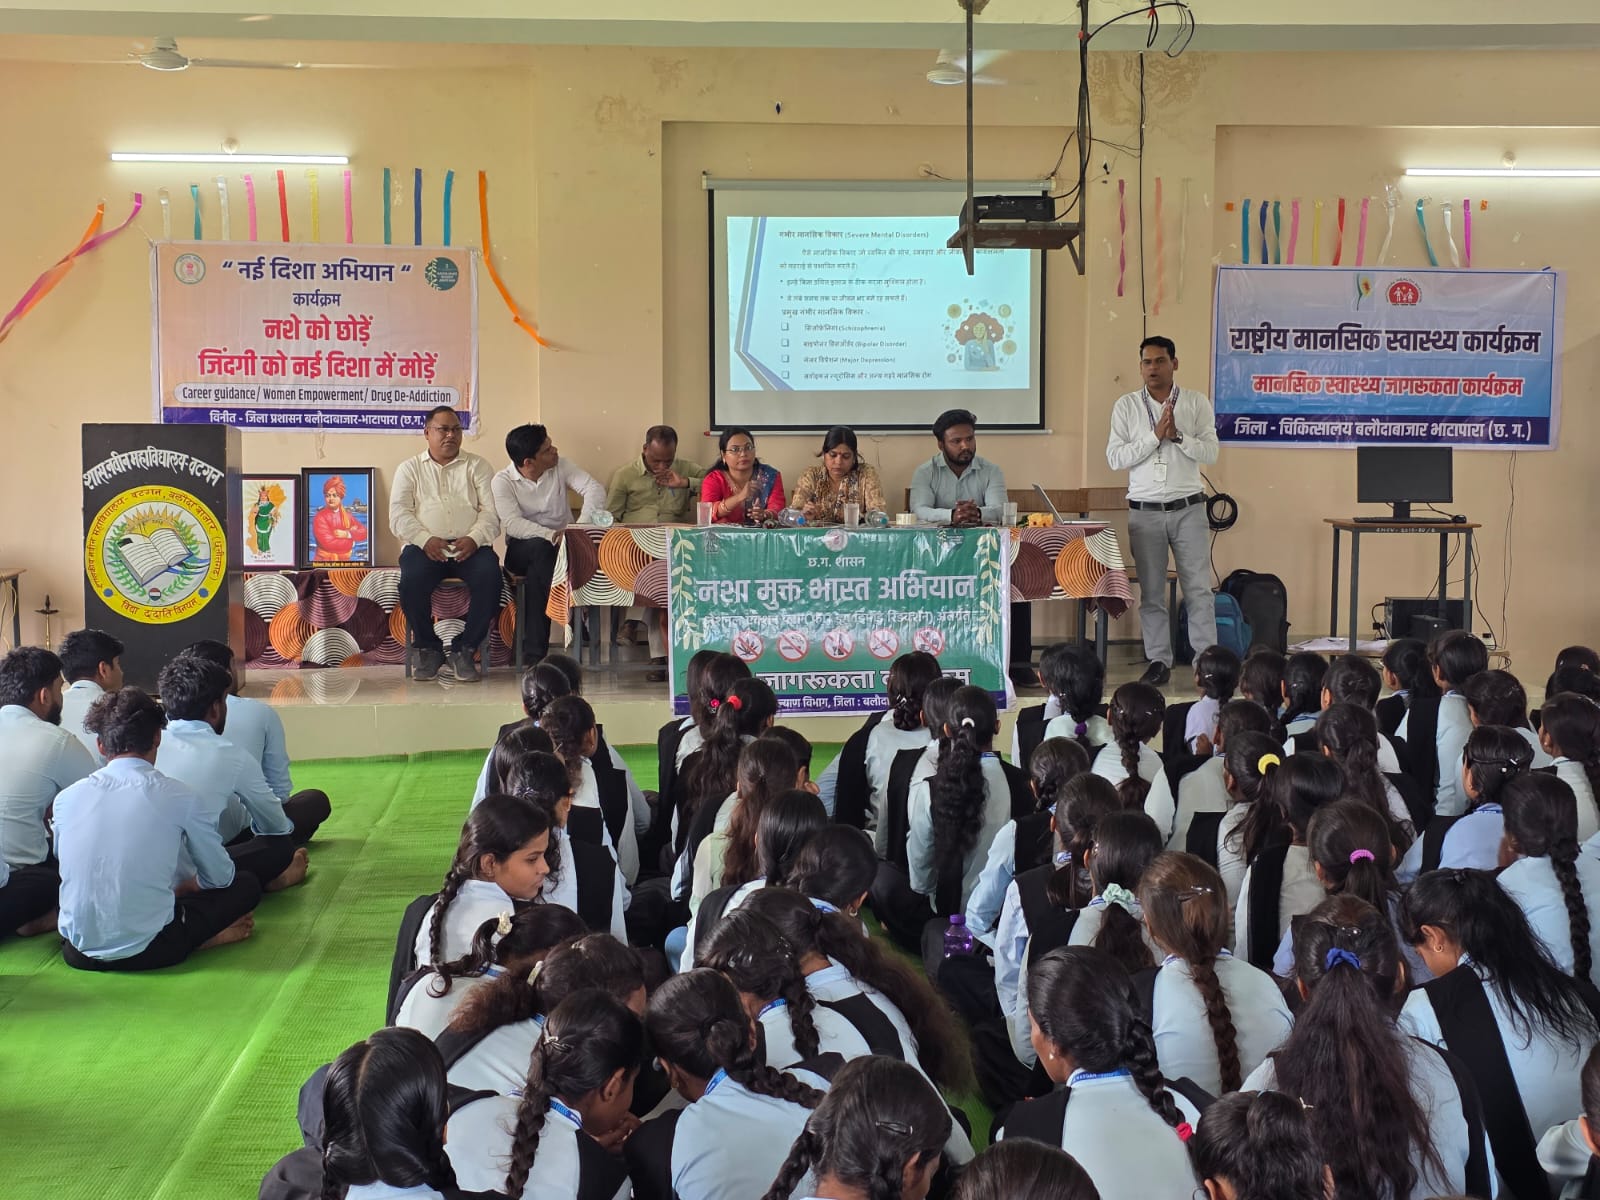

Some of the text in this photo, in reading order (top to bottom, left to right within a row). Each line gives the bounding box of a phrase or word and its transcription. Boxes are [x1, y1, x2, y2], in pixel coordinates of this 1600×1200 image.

[844, 231, 869, 239] (Severe
[871, 231, 894, 239] Mental
[896, 231, 929, 239] Disorders)
[238, 260, 266, 281] नई
[270, 257, 316, 280] दिशा
[322, 258, 395, 282] अभियान
[292, 289, 341, 307] कार्यक्रम
[263, 314, 374, 347] नशे को छोड़ें
[1230, 321, 1541, 354] राष्ट्रीय मानसिक स्वास्थ्य कार्यक्रम
[880, 340, 907, 348] Disorder)
[198, 347, 439, 384] जिंदगी को नई दिशा में मोड़ें
[1253, 370, 1523, 396] मानसिक स्वास्थ्य जागरूकता कार्यक्रम
[182, 386, 451, 403] Career guidance/ Women Empowerment/ Drug De-Addiction
[209, 409, 236, 423] विनीत
[245, 410, 268, 423] जिला
[270, 414, 302, 424] प्रशासन
[1234, 417, 1268, 435] जिला
[1279, 417, 1354, 436] चिकित्सालय
[1355, 418, 1428, 437] बलौदाबाजार
[1430, 422, 1485, 437] भाटापारा
[188, 457, 224, 487] वटगन
[835, 557, 866, 567] शासन
[696, 569, 977, 610] नशा मुक्त भारत अभियान
[756, 670, 875, 690] जागरूकता
[803, 695, 831, 709] विभाग,
[833, 695, 855, 707] जिला
